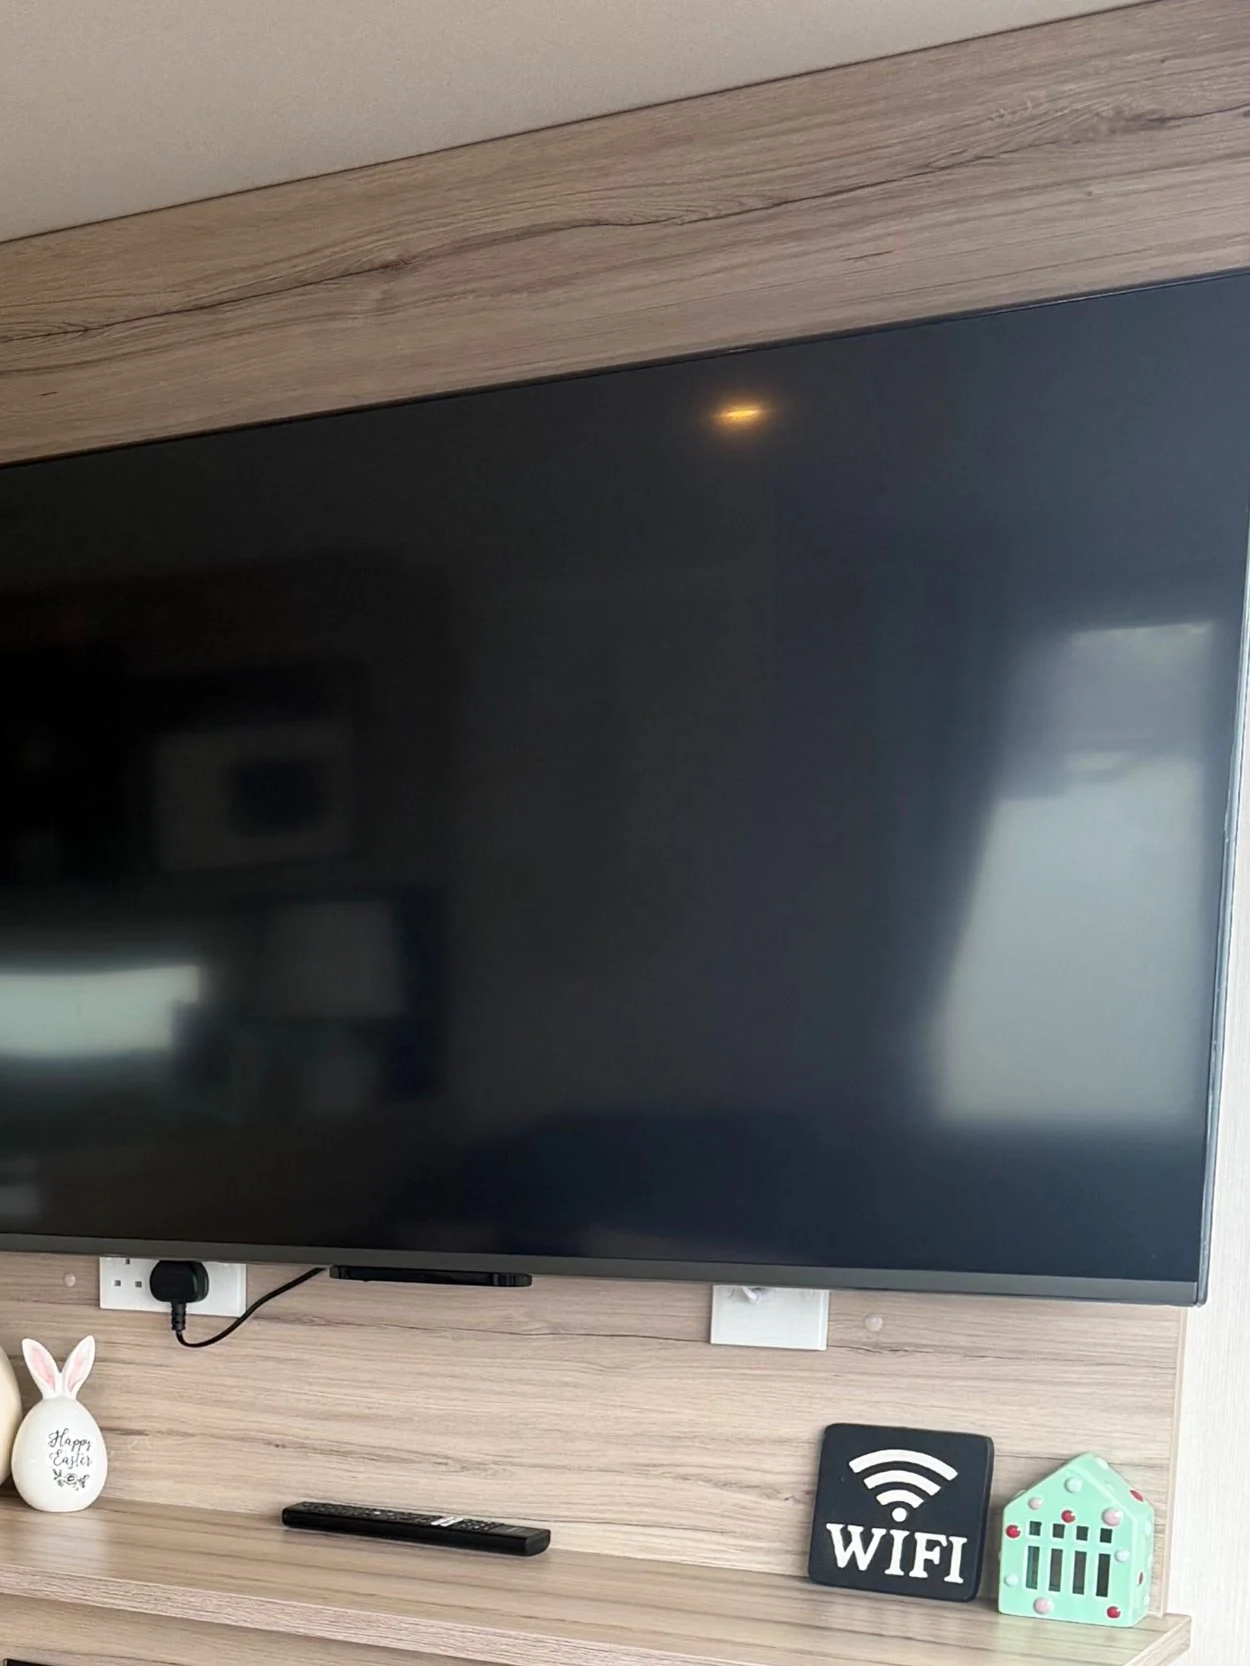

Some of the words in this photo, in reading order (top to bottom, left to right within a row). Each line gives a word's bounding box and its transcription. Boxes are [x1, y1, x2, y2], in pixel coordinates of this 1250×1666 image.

[48, 1427, 92, 1453] Happy
[49, 1448, 92, 1469] Easter
[826, 1522, 968, 1584] WIFI
